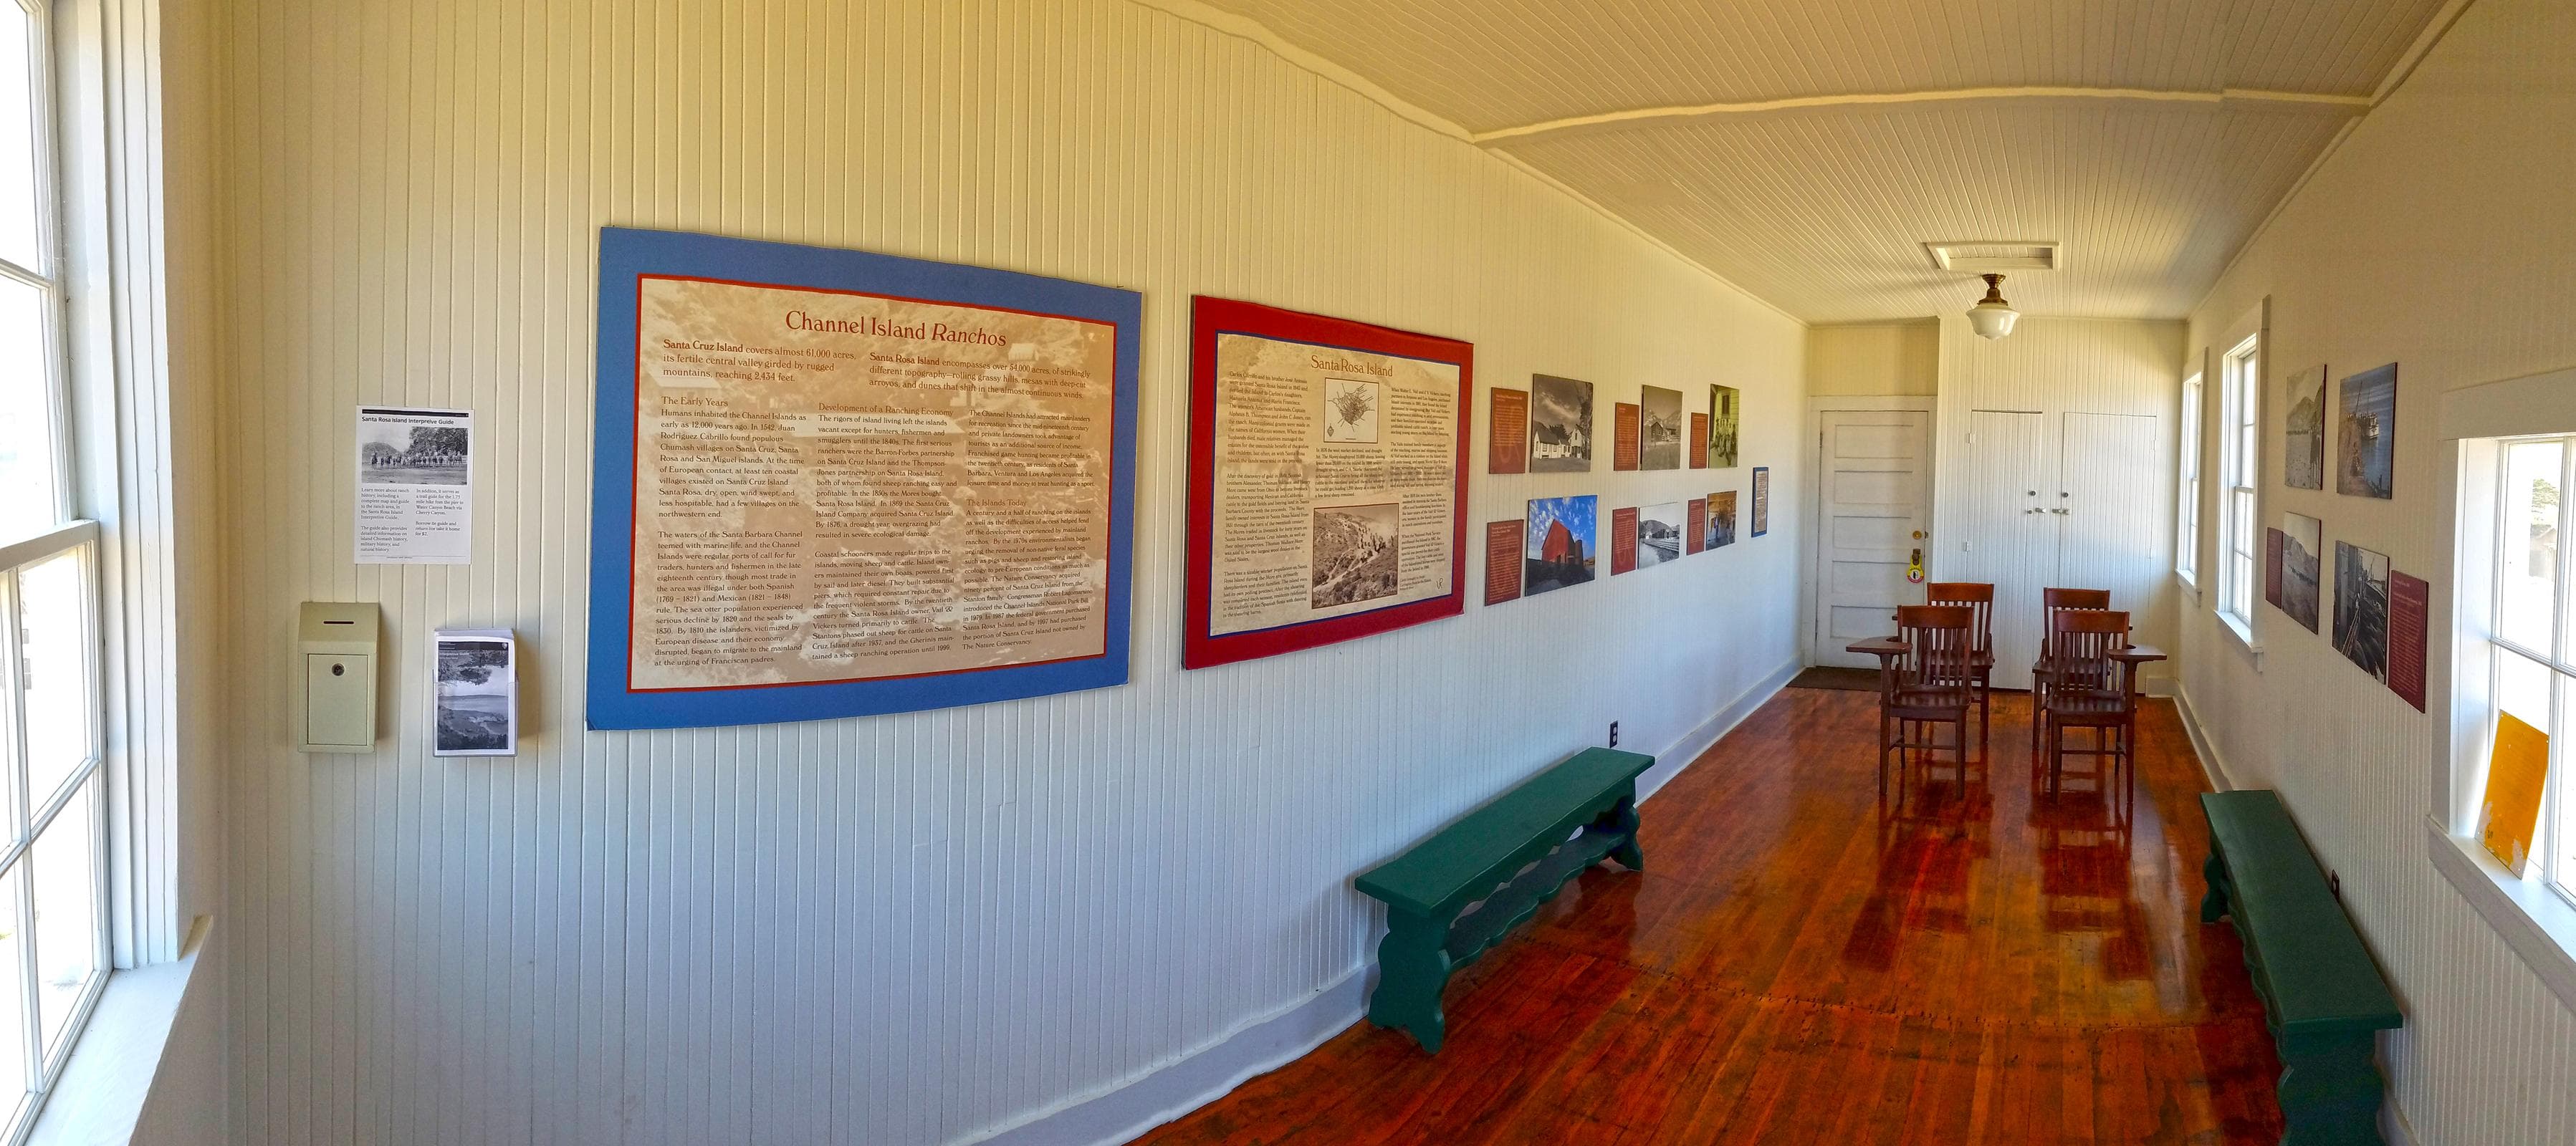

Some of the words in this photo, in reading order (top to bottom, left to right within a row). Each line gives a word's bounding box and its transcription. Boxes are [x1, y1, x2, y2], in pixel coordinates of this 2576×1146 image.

[785, 311, 866, 335] Channel
[871, 317, 925, 340] Island
[931, 322, 1007, 345] Ranchos
[663, 340, 690, 350] Santa
[691, 342, 715, 352] Cruz
[716, 343, 743, 353] Island
[774, 346, 806, 357] almost
[805, 347, 830, 359] 61,000
[663, 353, 675, 363] its
[676, 354, 704, 365] fertile
[704, 357, 736, 366] central
[737, 357, 764, 370] valley
[763, 359, 792, 370] girded
[793, 360, 804, 372] by
[806, 362, 835, 373] rugged
[869, 352, 895, 362] Santa
[895, 354, 915, 365] Rosa
[916, 355, 940, 366] Island
[941, 360, 992, 371] encompasses
[1008, 362, 1030, 374] 54,000
[1051, 366, 1060, 375] of
[1060, 367, 1091, 380] strikingly
[1311, 355, 1341, 371] Santa
[1340, 358, 1365, 374] Rosa
[1366, 360, 1394, 376] Island
[714, 370, 752, 382] reaching
[754, 371, 775, 382] 2,434
[869, 365, 902, 377] different
[975, 375, 1001, 386] grassy
[1043, 377, 1058, 387] with
[1059, 378, 1086, 391] deep-cut
[901, 380, 916, 388] and
[918, 380, 942, 390] dunes
[942, 382, 958, 391] that
[959, 383, 976, 393] shift
[977, 384, 987, 393] in
[987, 385, 1000, 394] the
[1000, 385, 1025, 395] almost
[1024, 387, 1062, 398] continuous
[661, 397, 679, 405] The
[680, 398, 704, 408] Early
[705, 398, 729, 406] Years
[818, 403, 868, 414] Development
[885, 405, 920, 416] Ranching
[920, 406, 954, 418] Economy
[661, 409, 692, 418] Humans
[694, 410, 727, 418] inhabited
[741, 411, 770, 420] Channel
[771, 412, 797, 420] Islands
[660, 432, 698, 442] Rodriguez
[699, 433, 729, 441] Cabrillo
[751, 434, 784, 444] populous
[1007, 499, 1027, 509] Today
[872, 529, 904, 539] ecological
